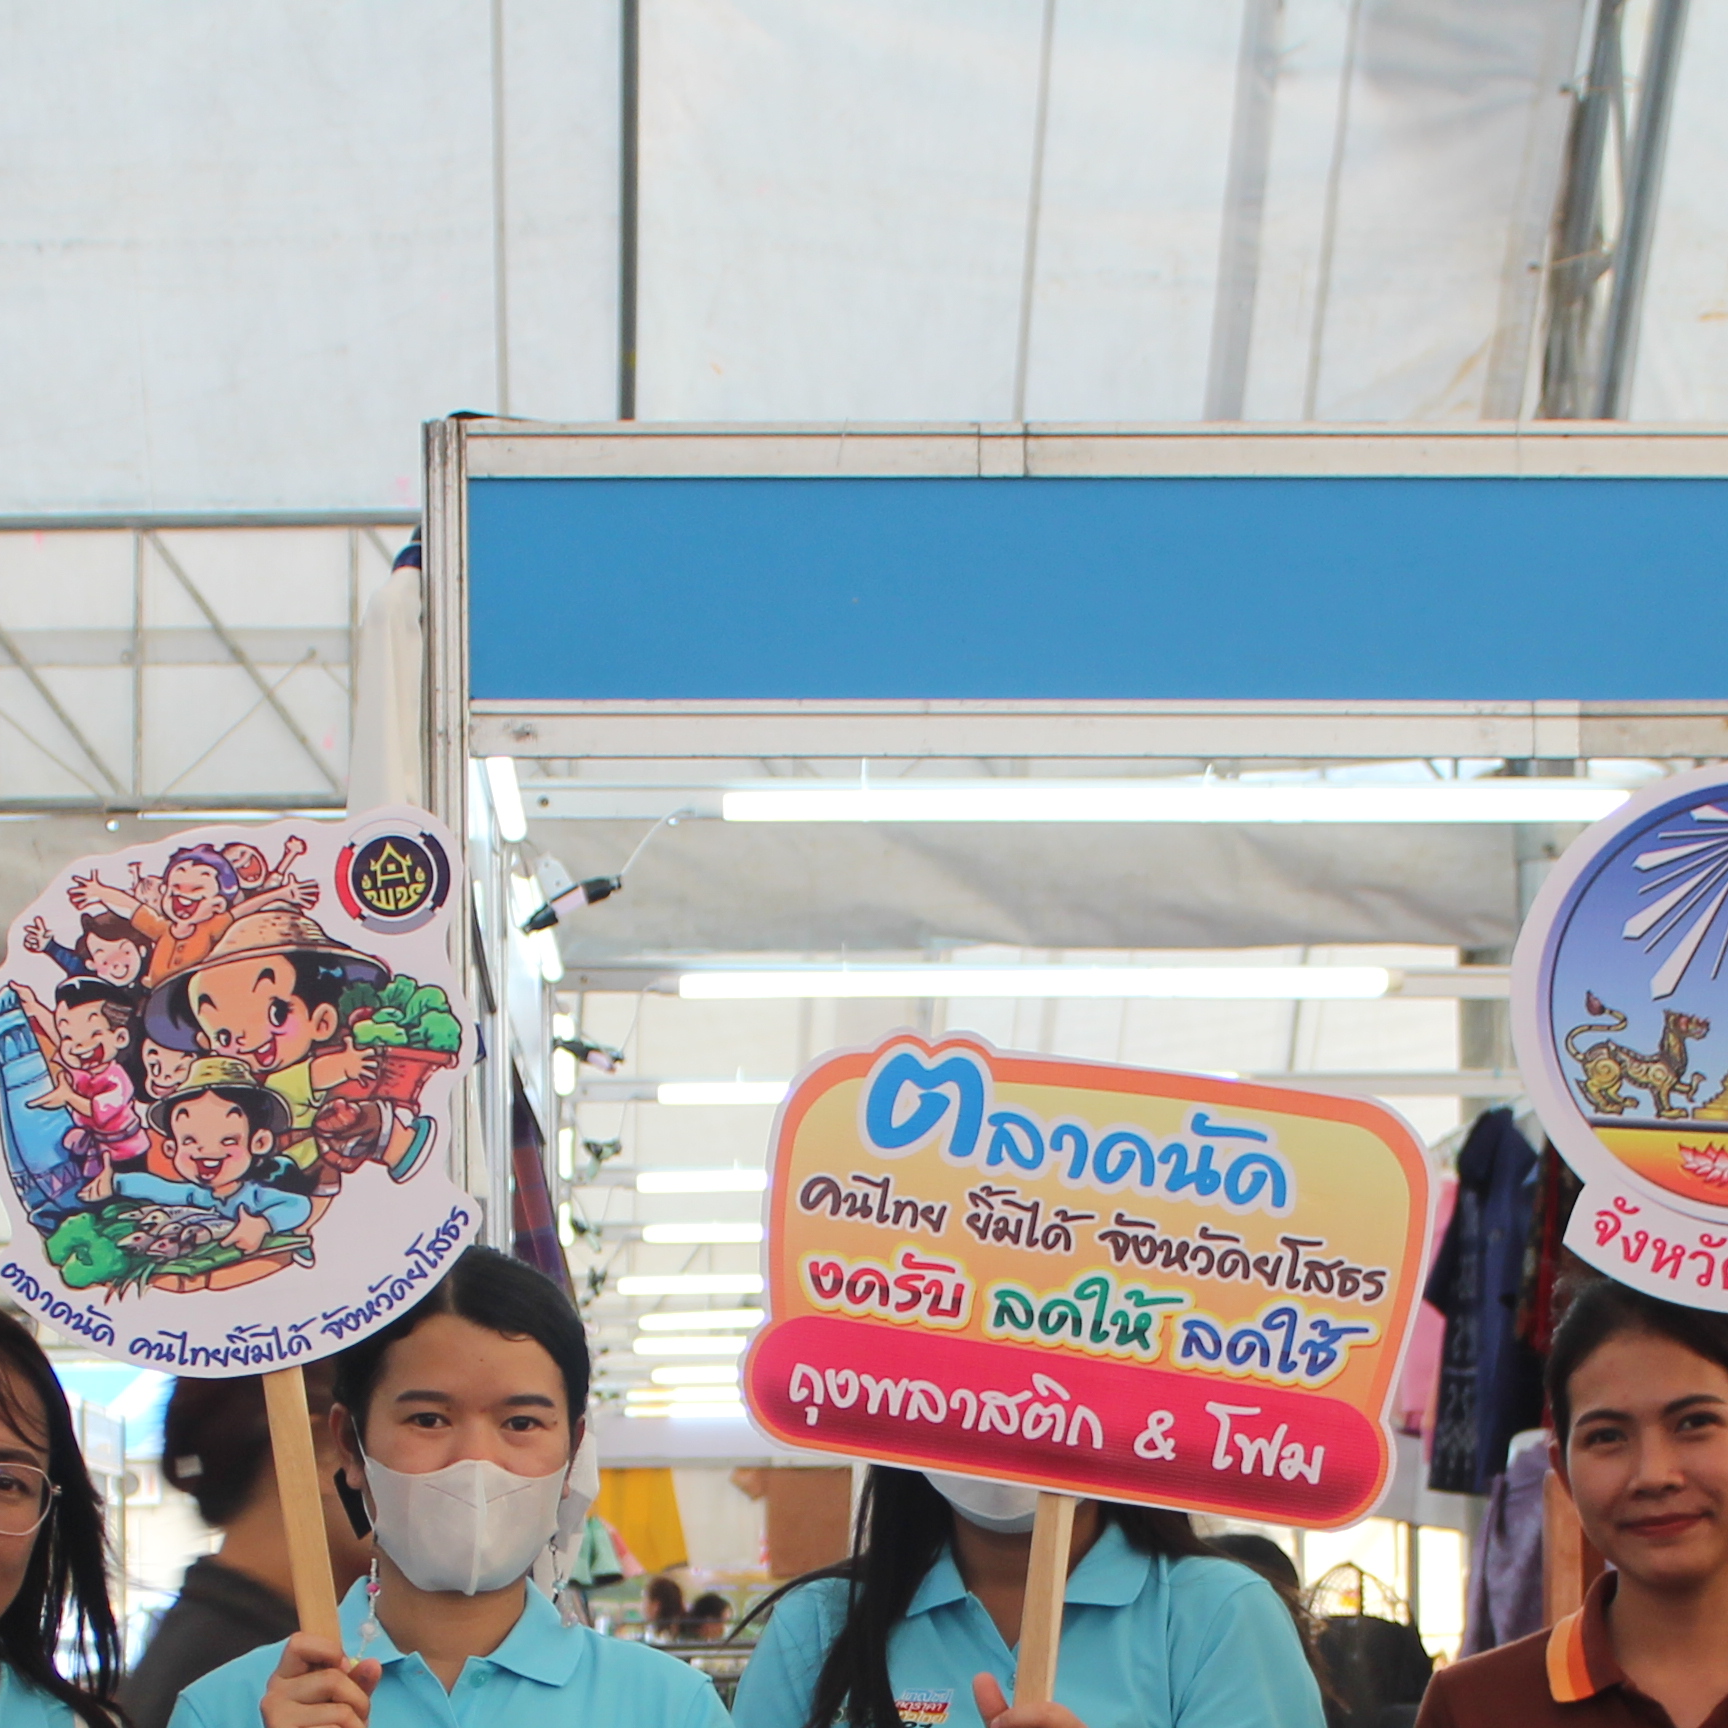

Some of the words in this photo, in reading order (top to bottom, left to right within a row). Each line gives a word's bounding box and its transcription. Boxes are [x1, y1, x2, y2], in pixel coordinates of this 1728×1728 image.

[866, 1052, 1288, 1208] ตลาดนัด
[0, 1263, 115, 1347] ตลาดนัด
[323, 1206, 471, 1339] จังหวัดยโสธร
[800, 1176, 947, 1233] คนไทย
[1099, 1211, 1386, 1298] จังหวัดยโสธร
[809, 1252, 965, 1321] งดรับ
[992, 1278, 1182, 1351] ลดให้
[1181, 1307, 1370, 1378] ลดใช้
[789, 1361, 1103, 1451] ถุงพลาสติก
[1134, 1412, 1177, 1460] &
[1206, 1402, 1325, 1485] โฟม
